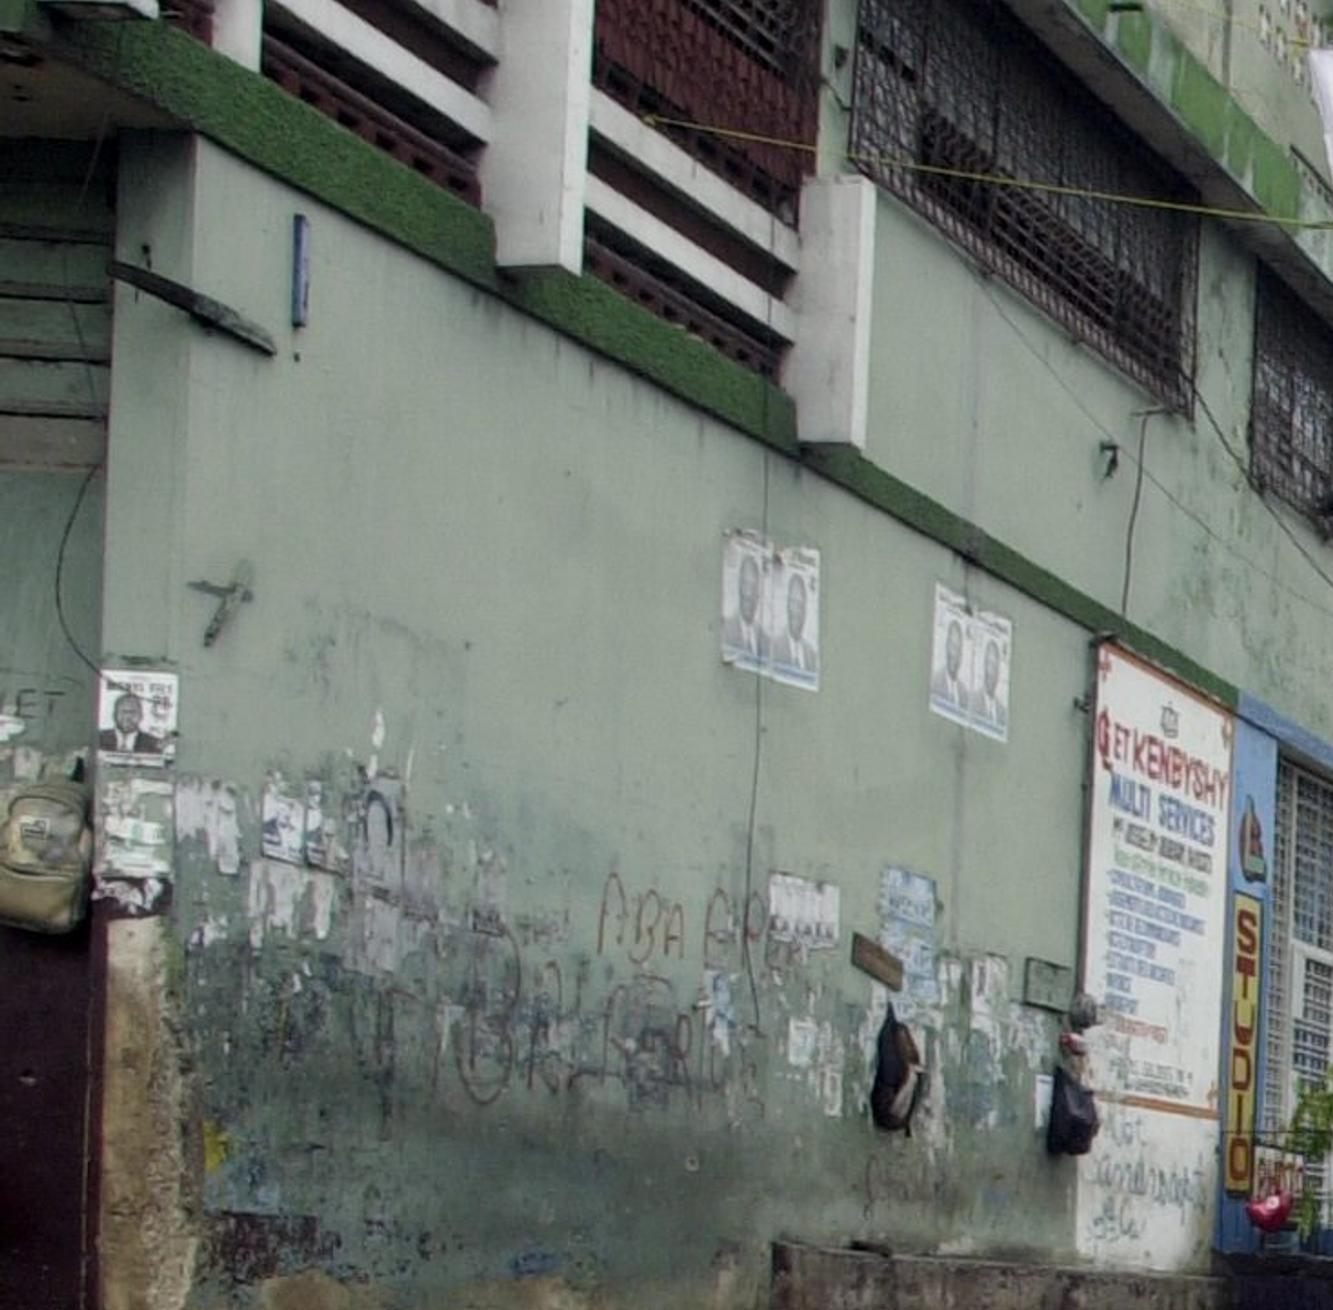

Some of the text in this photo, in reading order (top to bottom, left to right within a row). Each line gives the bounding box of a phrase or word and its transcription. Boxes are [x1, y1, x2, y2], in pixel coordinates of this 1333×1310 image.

[1108, 773, 1152, 823] MULTI
[1158, 792, 1215, 848] SERVICES
[1229, 908, 1259, 1182] STUDIO
